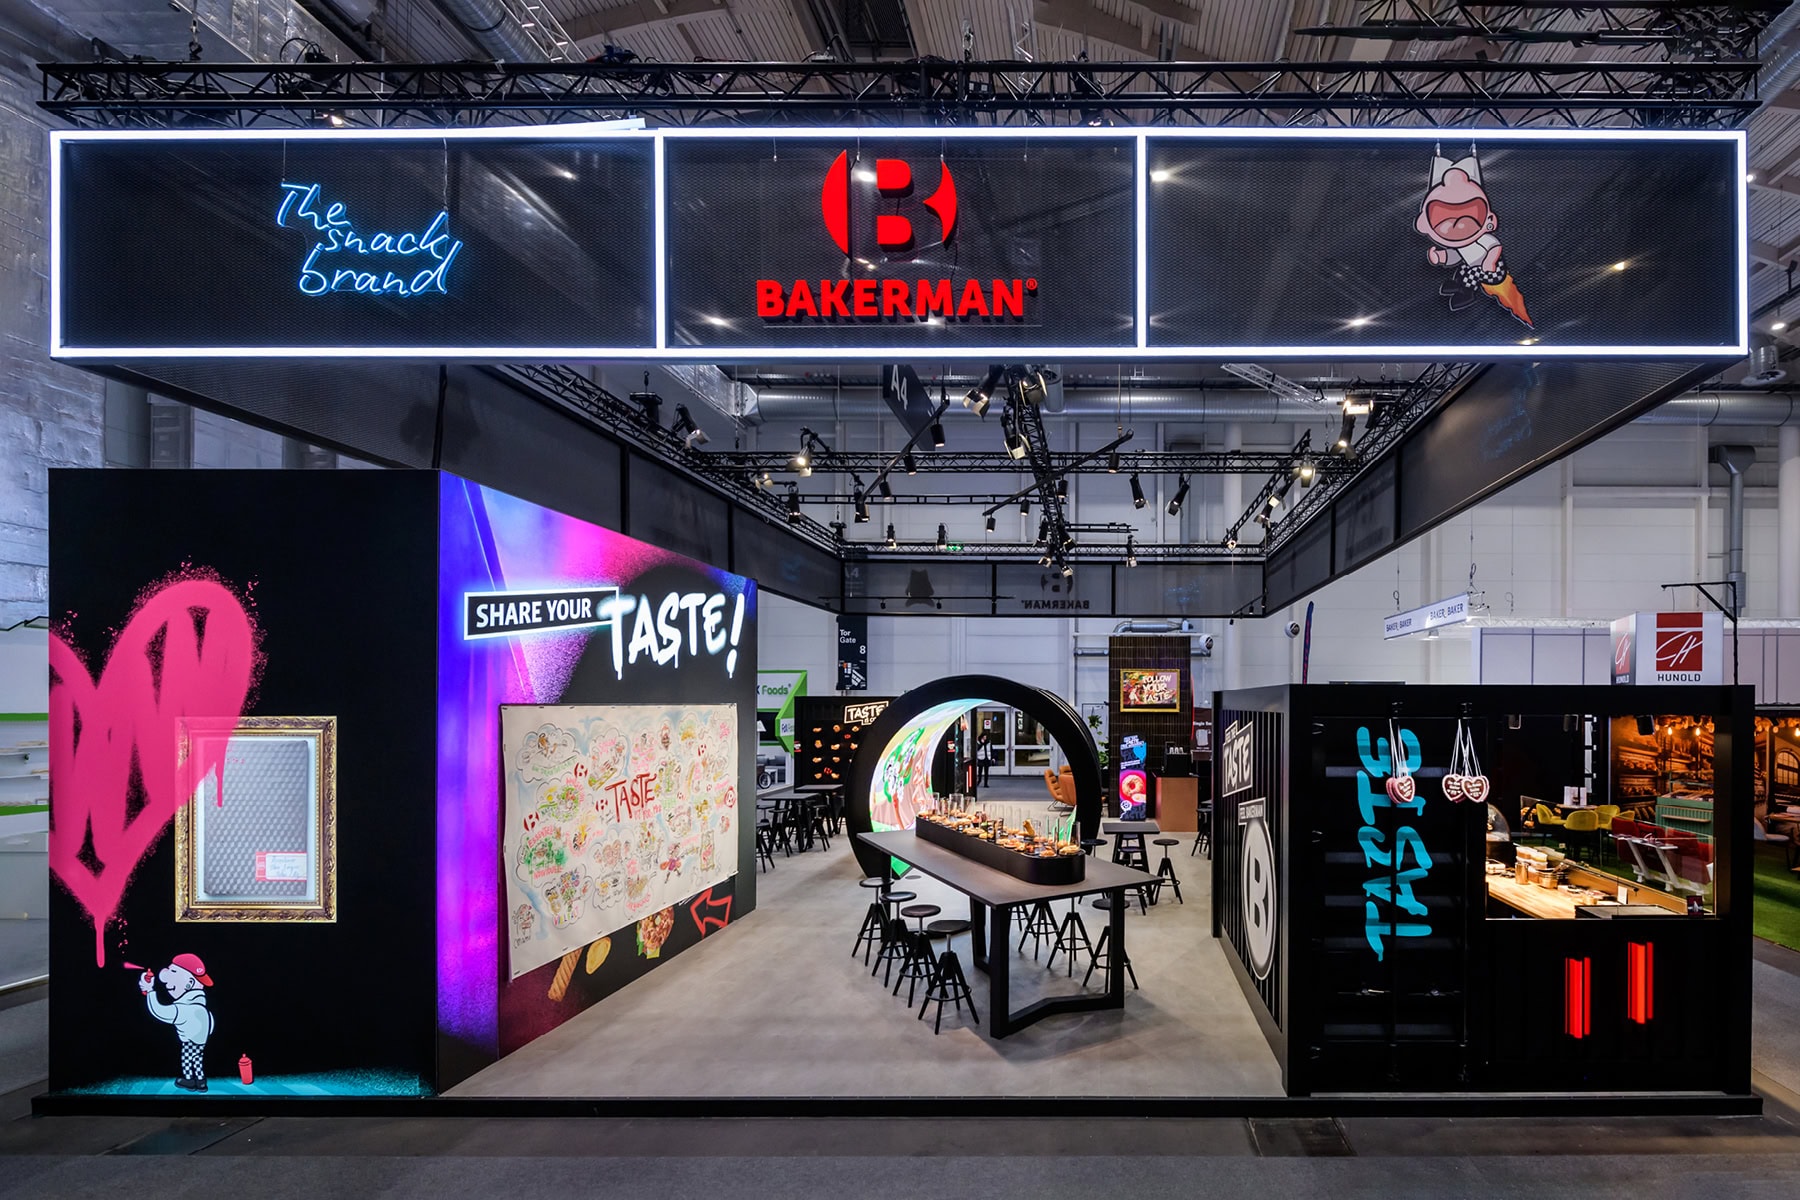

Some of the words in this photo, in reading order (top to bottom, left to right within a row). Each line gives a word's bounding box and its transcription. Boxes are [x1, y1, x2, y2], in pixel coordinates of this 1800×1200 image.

[276, 183, 350, 231] The
[325, 210, 451, 260] snack
[299, 240, 463, 296] brand
[1447, 603, 1464, 616] BAKER
[476, 600, 542, 628] SHARE
[546, 597, 592, 621] YOUR
[597, 591, 745, 681] TASTE!
[859, 645, 866, 654] 8
[1143, 674, 1171, 683] FOLLOW
[1143, 683, 1168, 693] YOUR
[1144, 691, 1171, 703] TASTE
[1657, 673, 1701, 682] HUNOLD
[1224, 733, 1250, 792] TASTE
[604, 773, 658, 823] TASTE
[1356, 726, 1432, 962] TASTE
